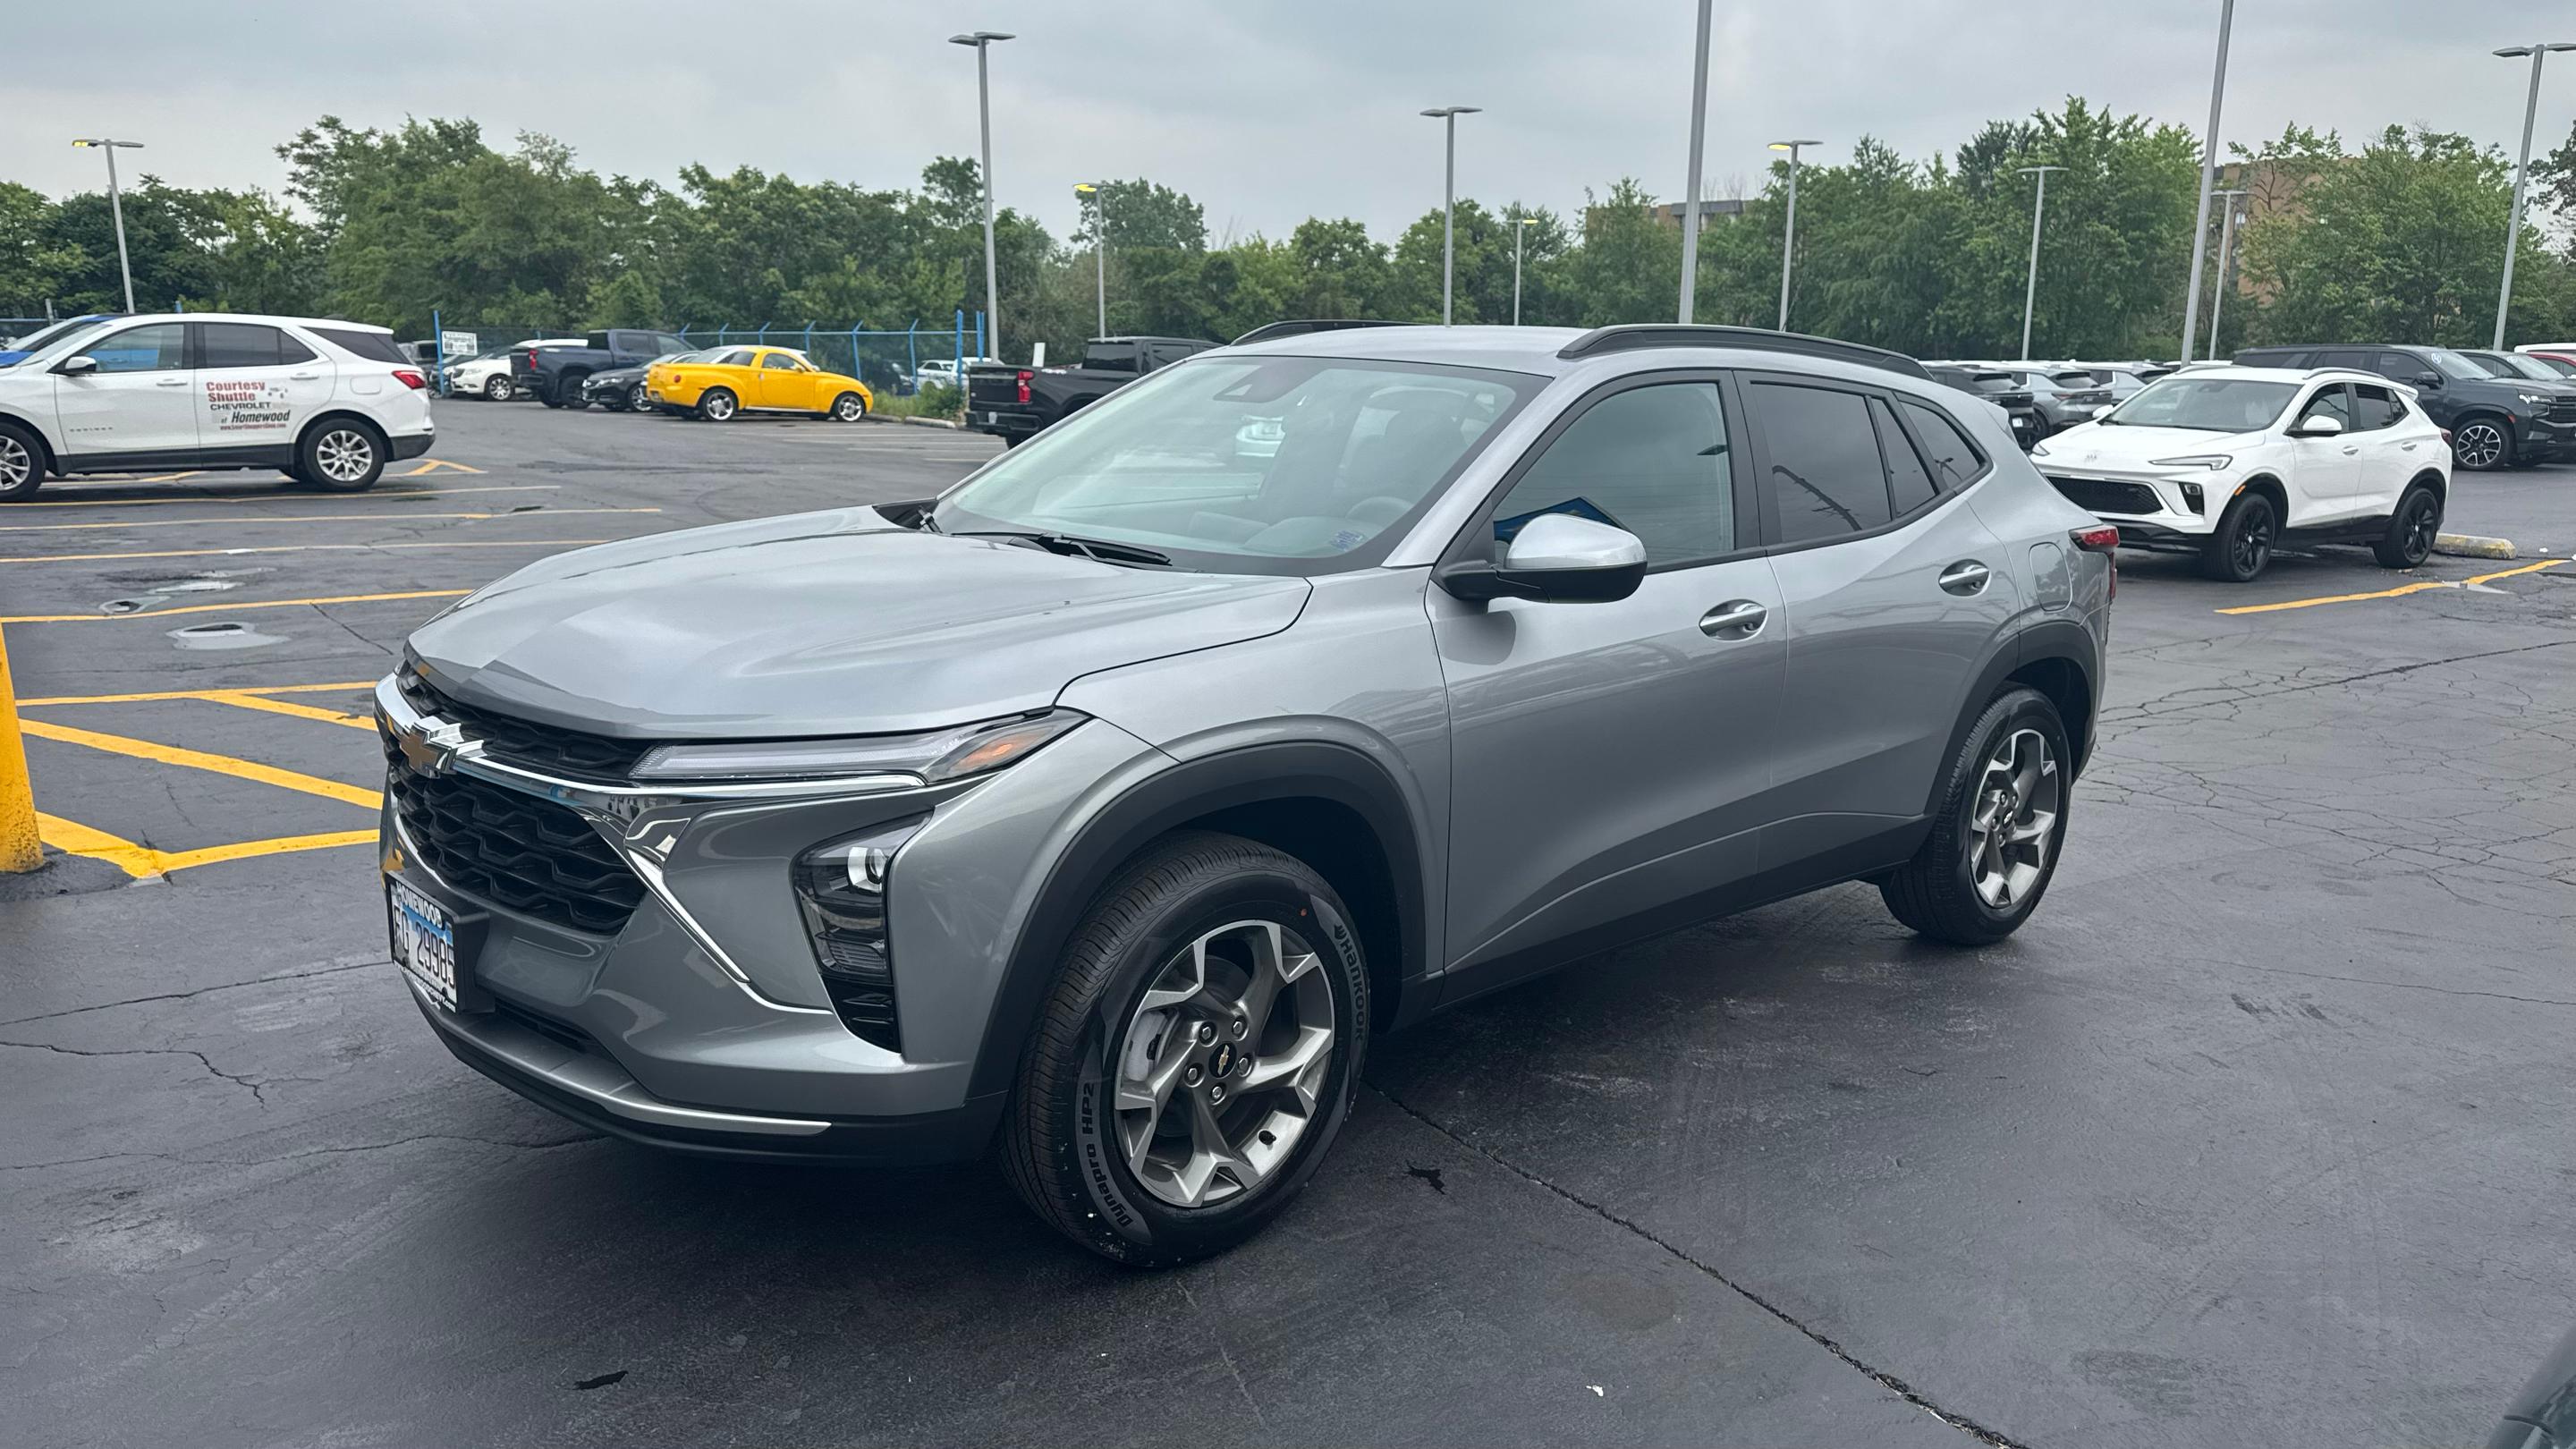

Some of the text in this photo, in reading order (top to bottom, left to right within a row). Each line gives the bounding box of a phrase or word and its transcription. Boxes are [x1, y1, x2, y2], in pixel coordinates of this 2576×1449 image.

[206, 381, 266, 392] Courtesy
[208, 392, 256, 402] Shuttle
[210, 402, 271, 411] CHEVROLET
[231, 410, 291, 423] Homewood
[415, 920, 455, 989] 29985
[1339, 941, 1367, 1041] Hankook
[1080, 1081, 1133, 1228] Dynapro HP2
